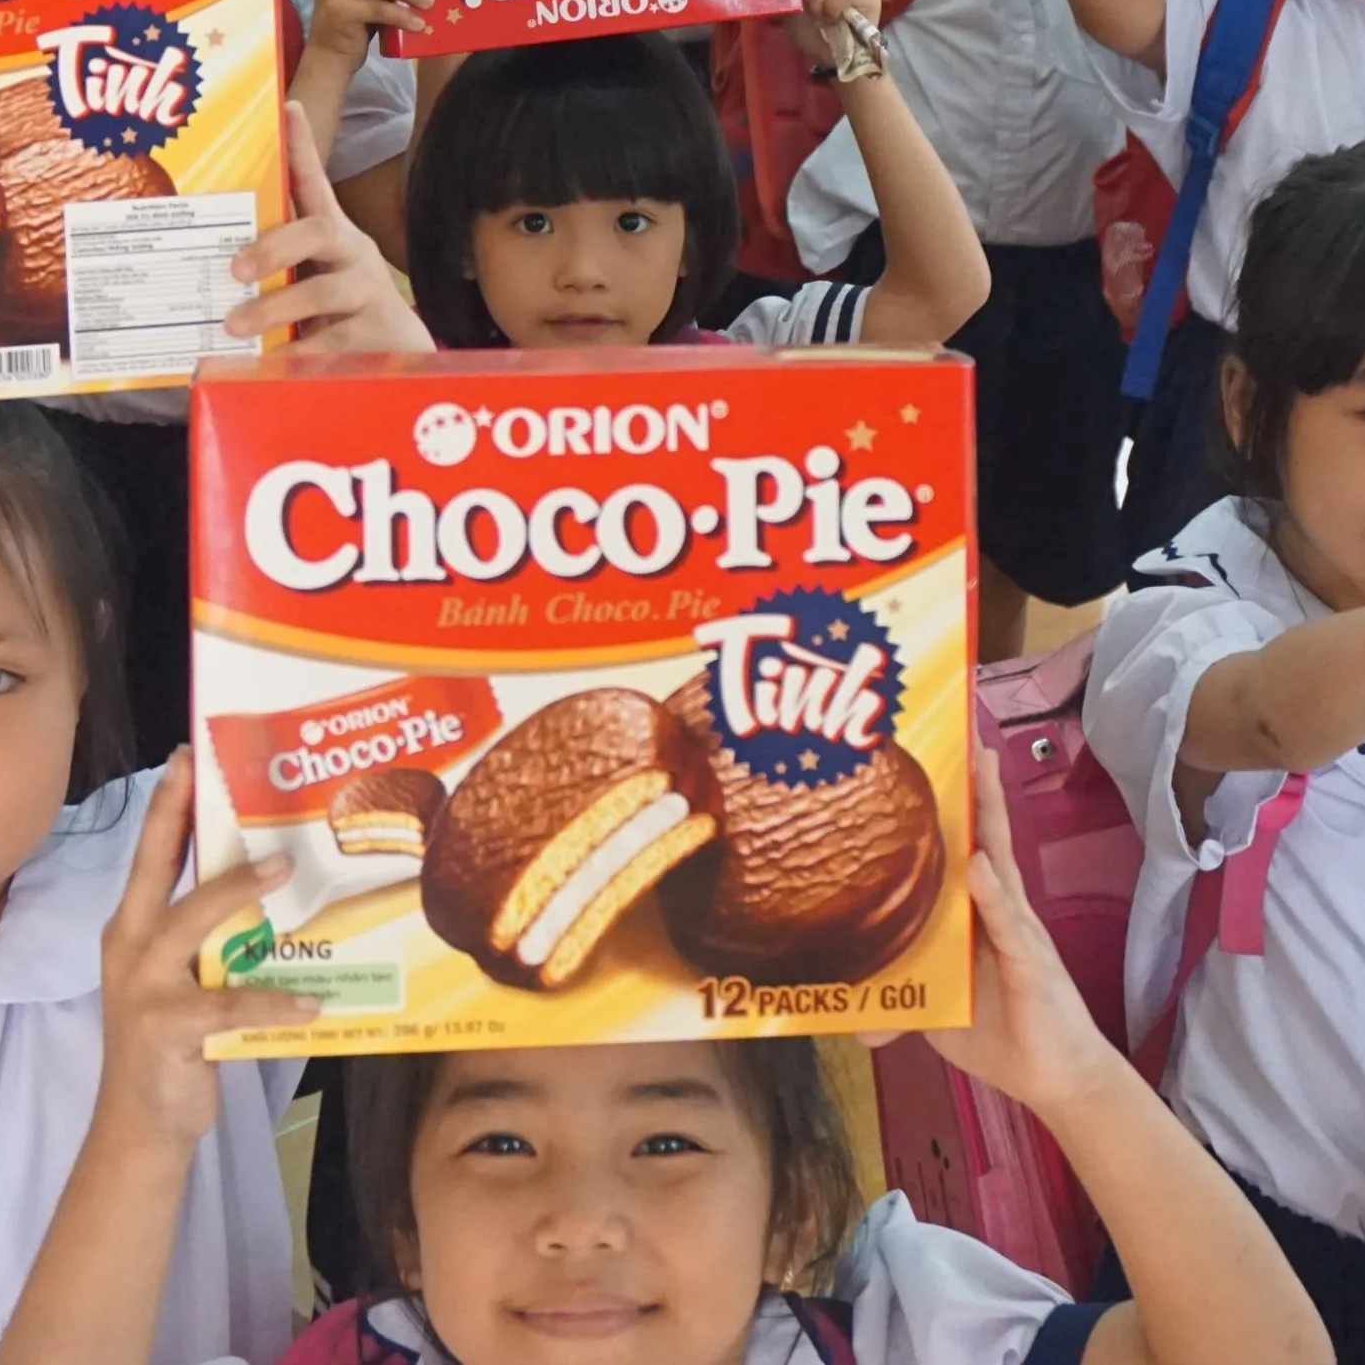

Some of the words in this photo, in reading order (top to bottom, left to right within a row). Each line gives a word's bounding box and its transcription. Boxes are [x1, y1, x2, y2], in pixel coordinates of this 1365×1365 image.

[37, 24, 189, 126] Tình
[491, 403, 710, 458] ORION
[243, 445, 914, 592] Choco·Pie
[437, 593, 528, 629] Bánh
[693, 614, 885, 749] Tình
[321, 695, 410, 731] ORION
[268, 710, 463, 793] Choco·Pie
[245, 932, 333, 961] KHÔNG
[697, 976, 753, 1021] 12
[756, 989, 850, 1016] PACKS
[858, 988, 870, 1013] /
[880, 977, 927, 1011] GÓI
